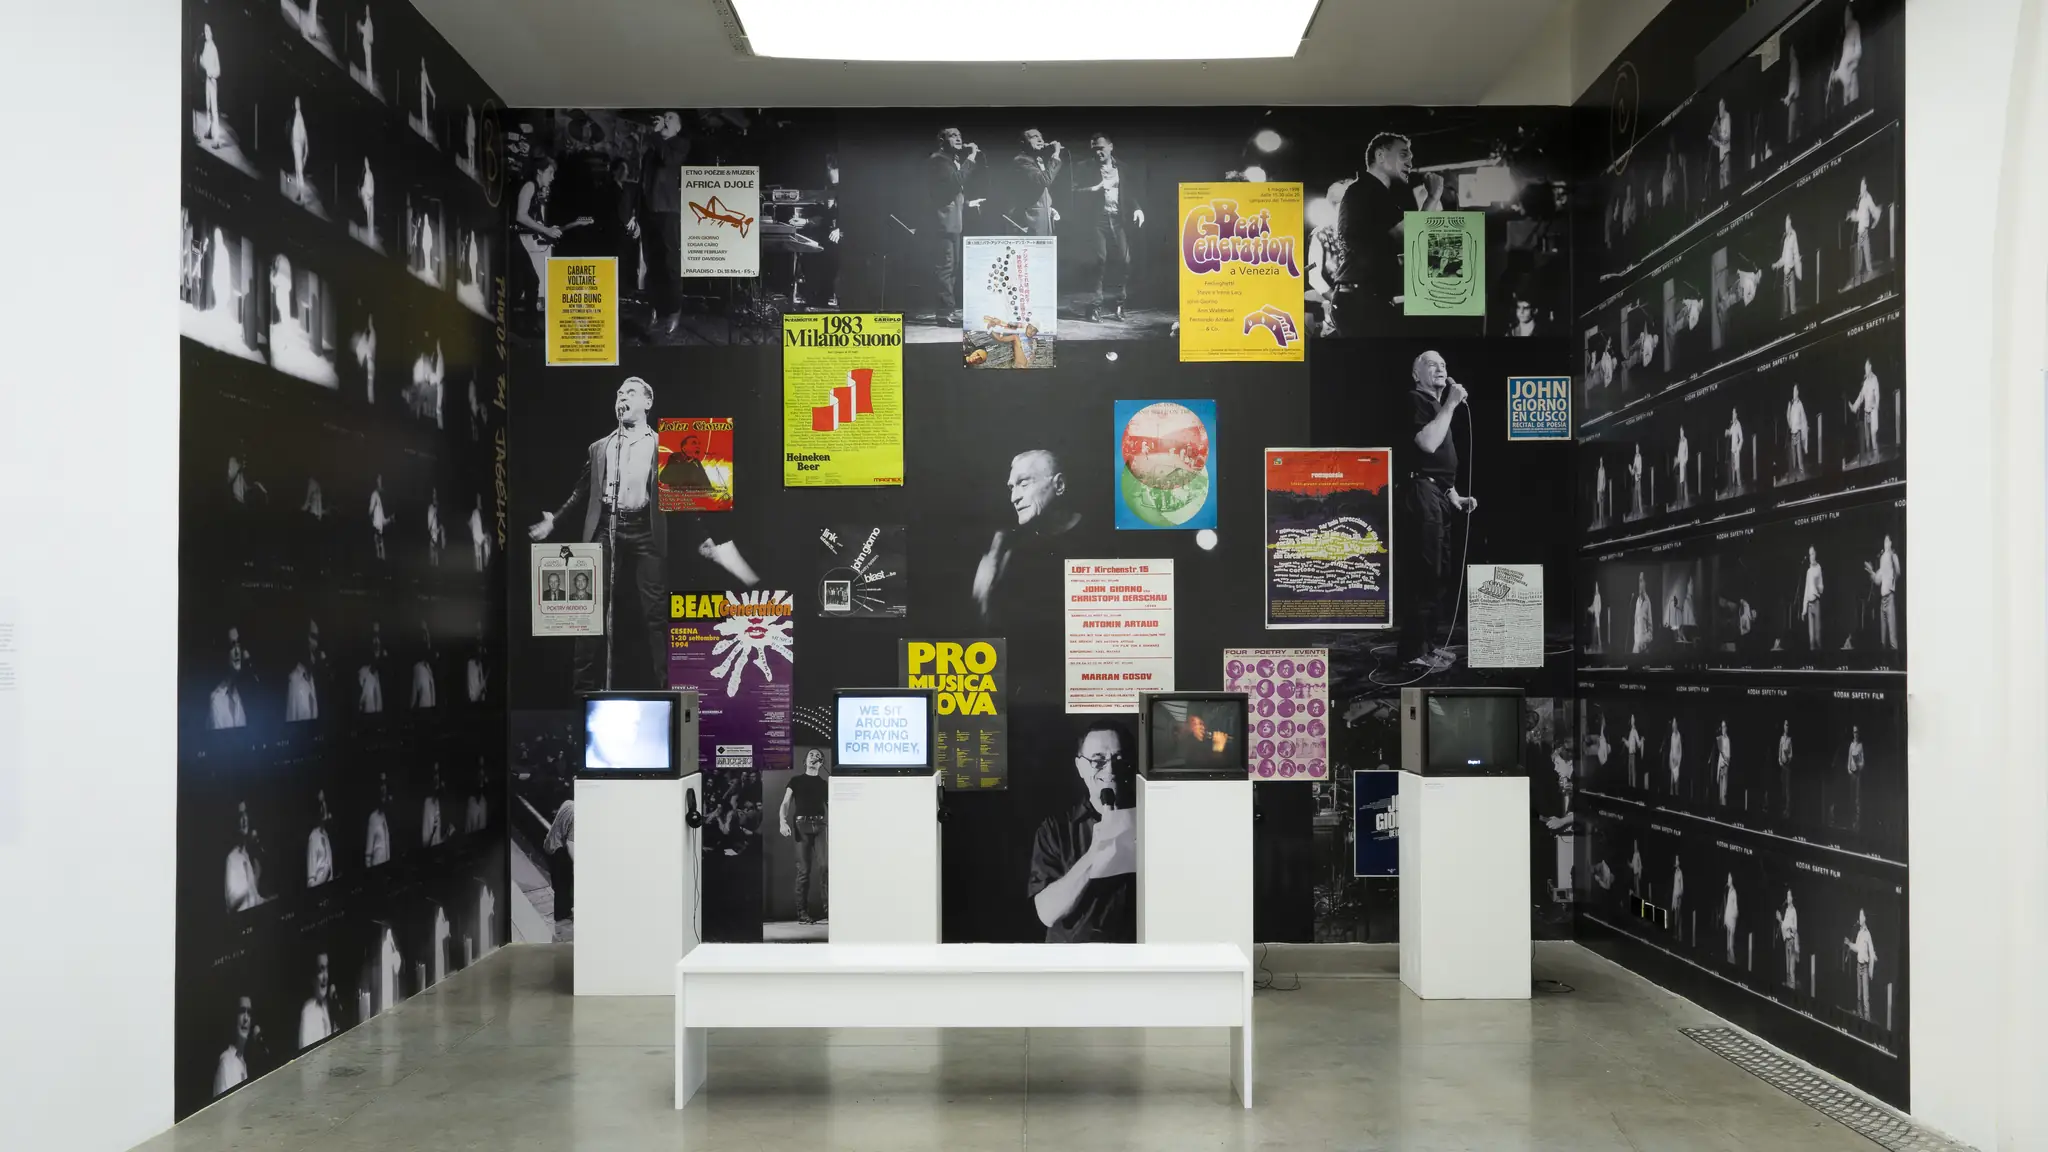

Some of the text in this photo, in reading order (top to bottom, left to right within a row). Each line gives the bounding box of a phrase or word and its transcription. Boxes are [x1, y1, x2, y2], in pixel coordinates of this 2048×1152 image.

[1796, 156, 1842, 188] KODAK SAFETY FILM
[686, 180, 720, 188] AFRICA
[1210, 198, 1270, 239] Beat
[1182, 204, 1300, 278] Generation
[568, 266, 596, 276] CABARET
[1239, 266, 1280, 276] Venezia
[568, 276, 596, 286] VOLTAIRE
[562, 294, 602, 303] BLAGO BUNG
[822, 316, 862, 334] 1983
[1847, 311, 1900, 337] KODAK SAFETY FILM
[785, 328, 901, 347] Milano suono
[1757, 352, 1799, 372] KODAK SAFETY FILM
[1512, 380, 1566, 398] JOHN
[1512, 398, 1567, 411] GIORNO
[1513, 411, 1566, 422] EN CUSCO
[786, 453, 830, 461] Heineken
[797, 462, 820, 471] Beer
[1794, 518, 1809, 526] KODAK
[1811, 513, 1828, 523] SAFETY
[822, 528, 838, 543] link
[1730, 530, 1744, 539] SAFETY
[850, 552, 867, 572] john
[864, 570, 886, 583] blast
[671, 595, 791, 618] BEAT Generation
[908, 642, 997, 675] PRO
[908, 675, 997, 692] MUSICA
[938, 692, 997, 715] OVA
[860, 705, 902, 716] WE SIT
[856, 718, 908, 728] AROUND
[854, 730, 908, 740] PRAYING
[845, 742, 919, 755] FOR MONEY,
[1796, 861, 1841, 878] KODAK SAFETY FILM
